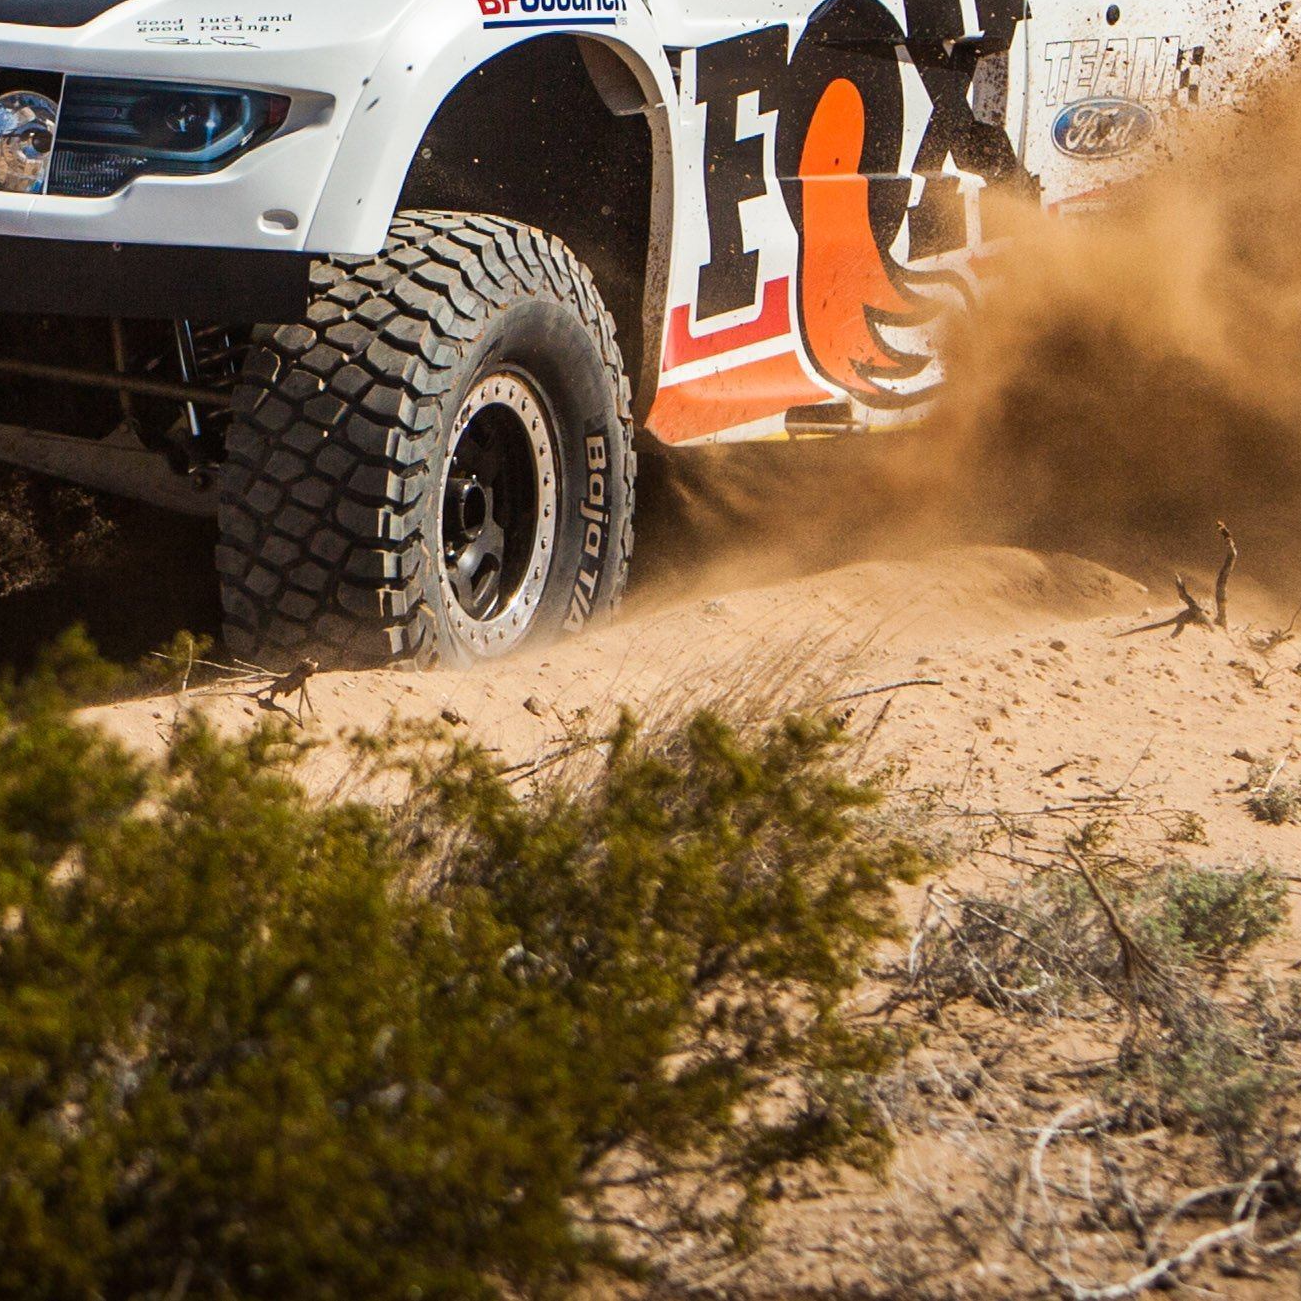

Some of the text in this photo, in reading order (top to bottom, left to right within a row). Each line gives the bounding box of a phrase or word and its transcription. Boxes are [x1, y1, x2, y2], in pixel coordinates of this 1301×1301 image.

[137, 13, 293, 26] Good luck and
[137, 24, 185, 33] good
[1045, 35, 1181, 106] TEAM
[1062, 105, 1142, 152] Ford
[563, 436, 609, 633] Baja T/A
